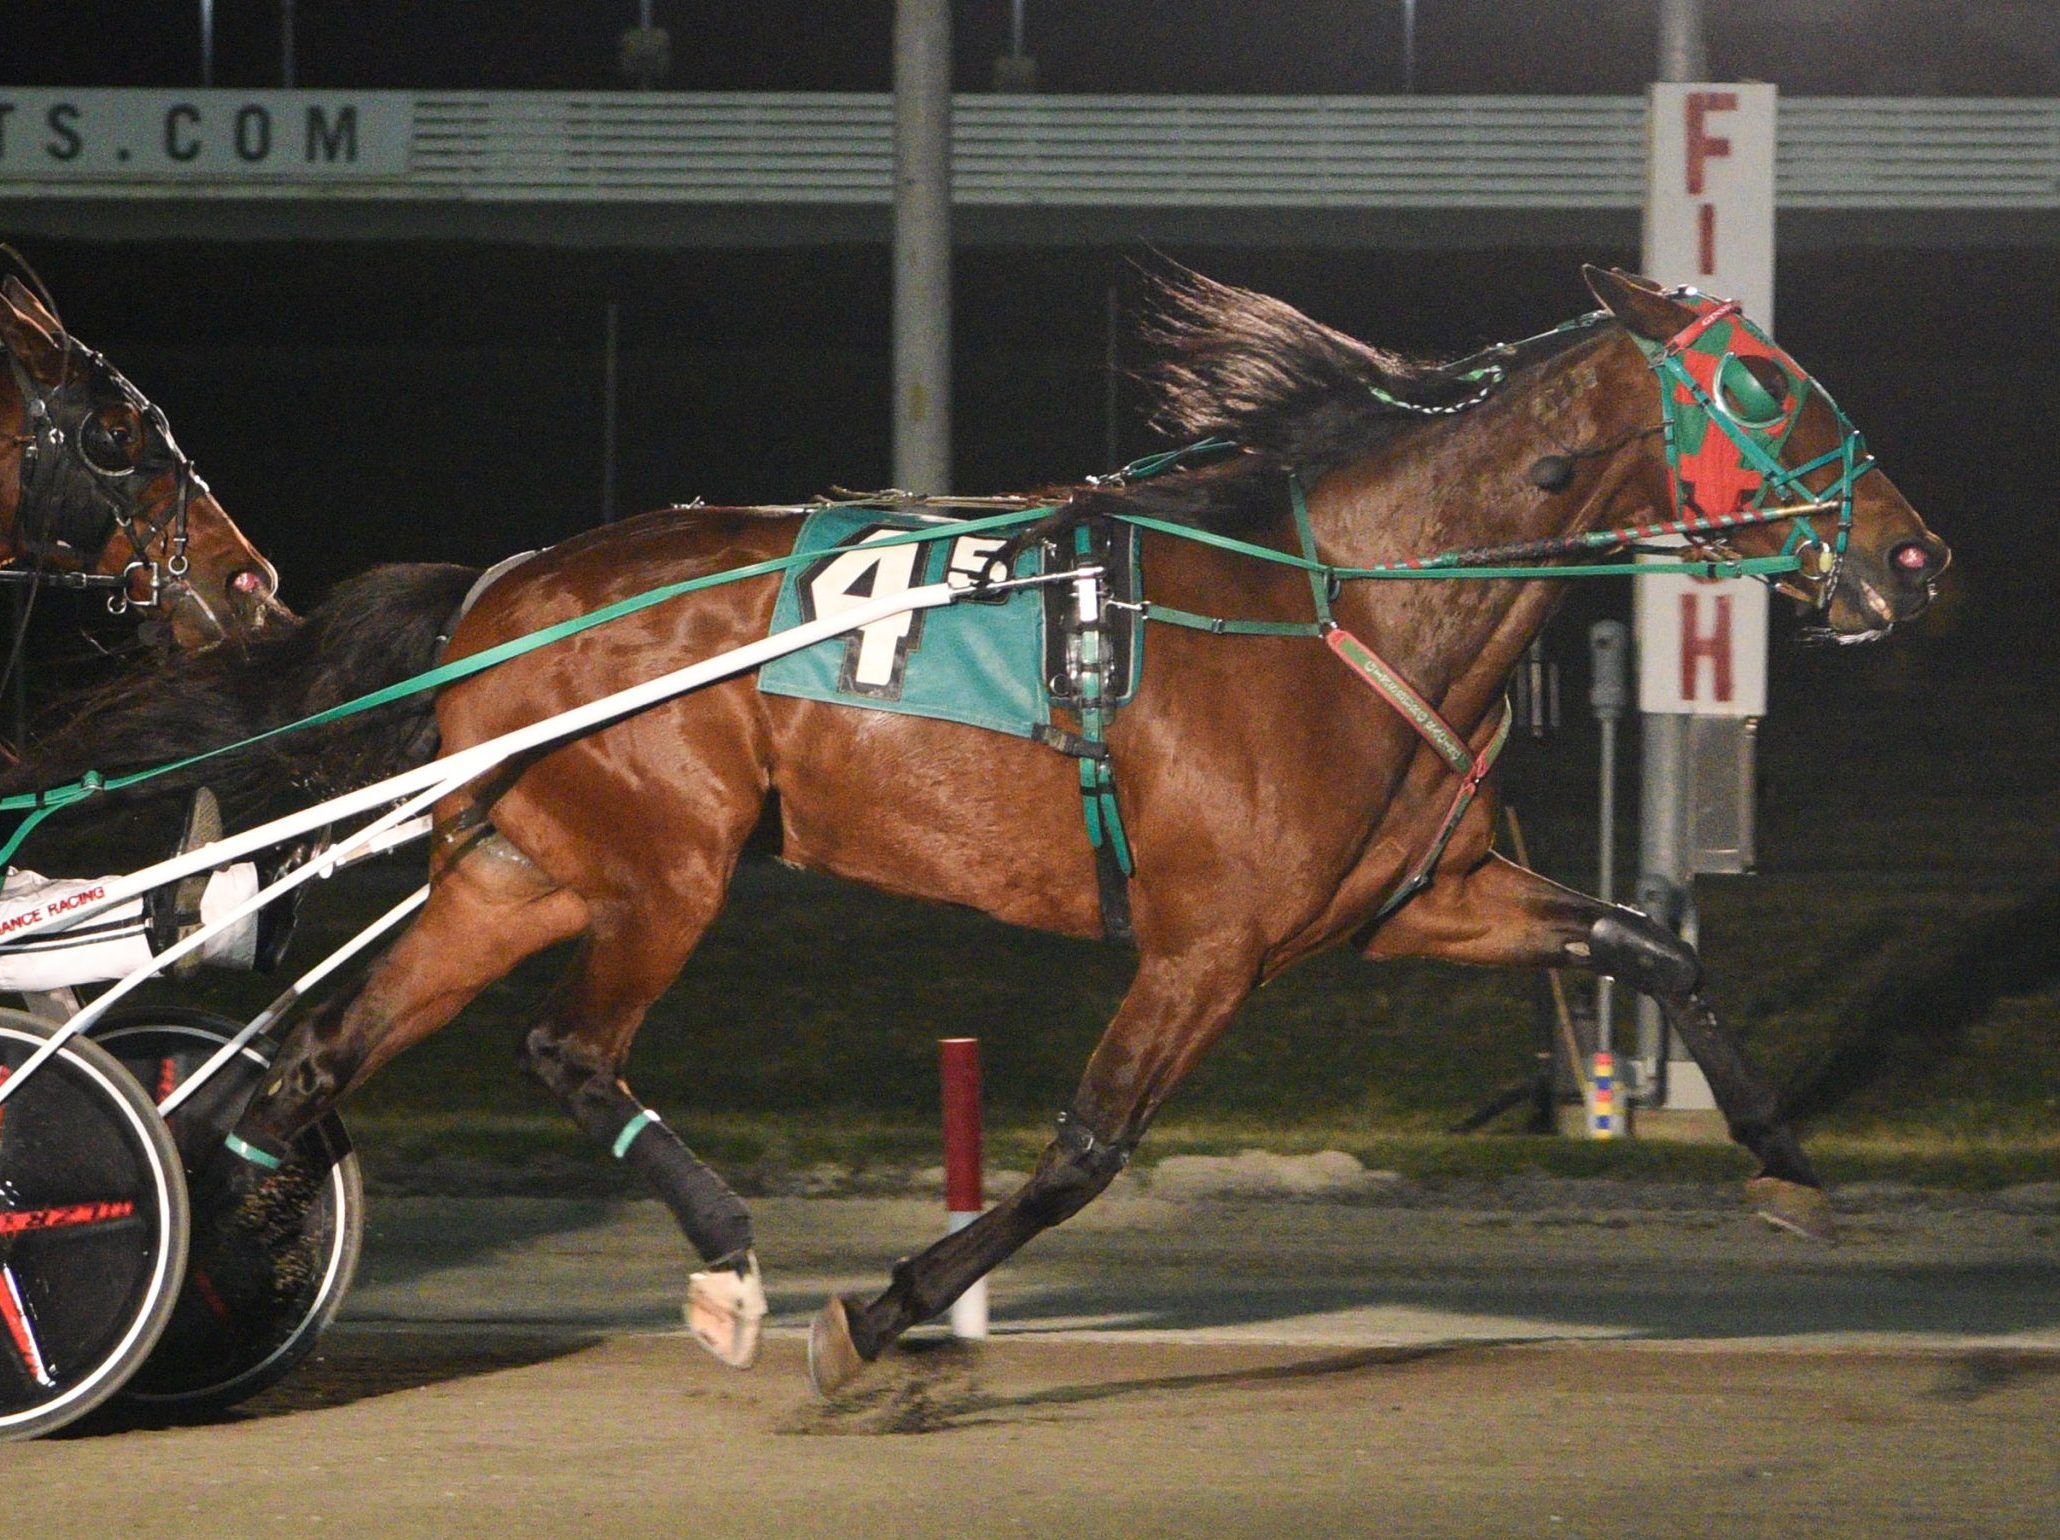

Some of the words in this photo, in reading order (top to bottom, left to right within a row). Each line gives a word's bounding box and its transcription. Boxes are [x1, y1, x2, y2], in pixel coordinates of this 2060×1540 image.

[809, 527, 921, 687] 4
[948, 535, 1008, 592] 5
[0, 908, 42, 936] ANCE
[47, 886, 105, 917] RACING
